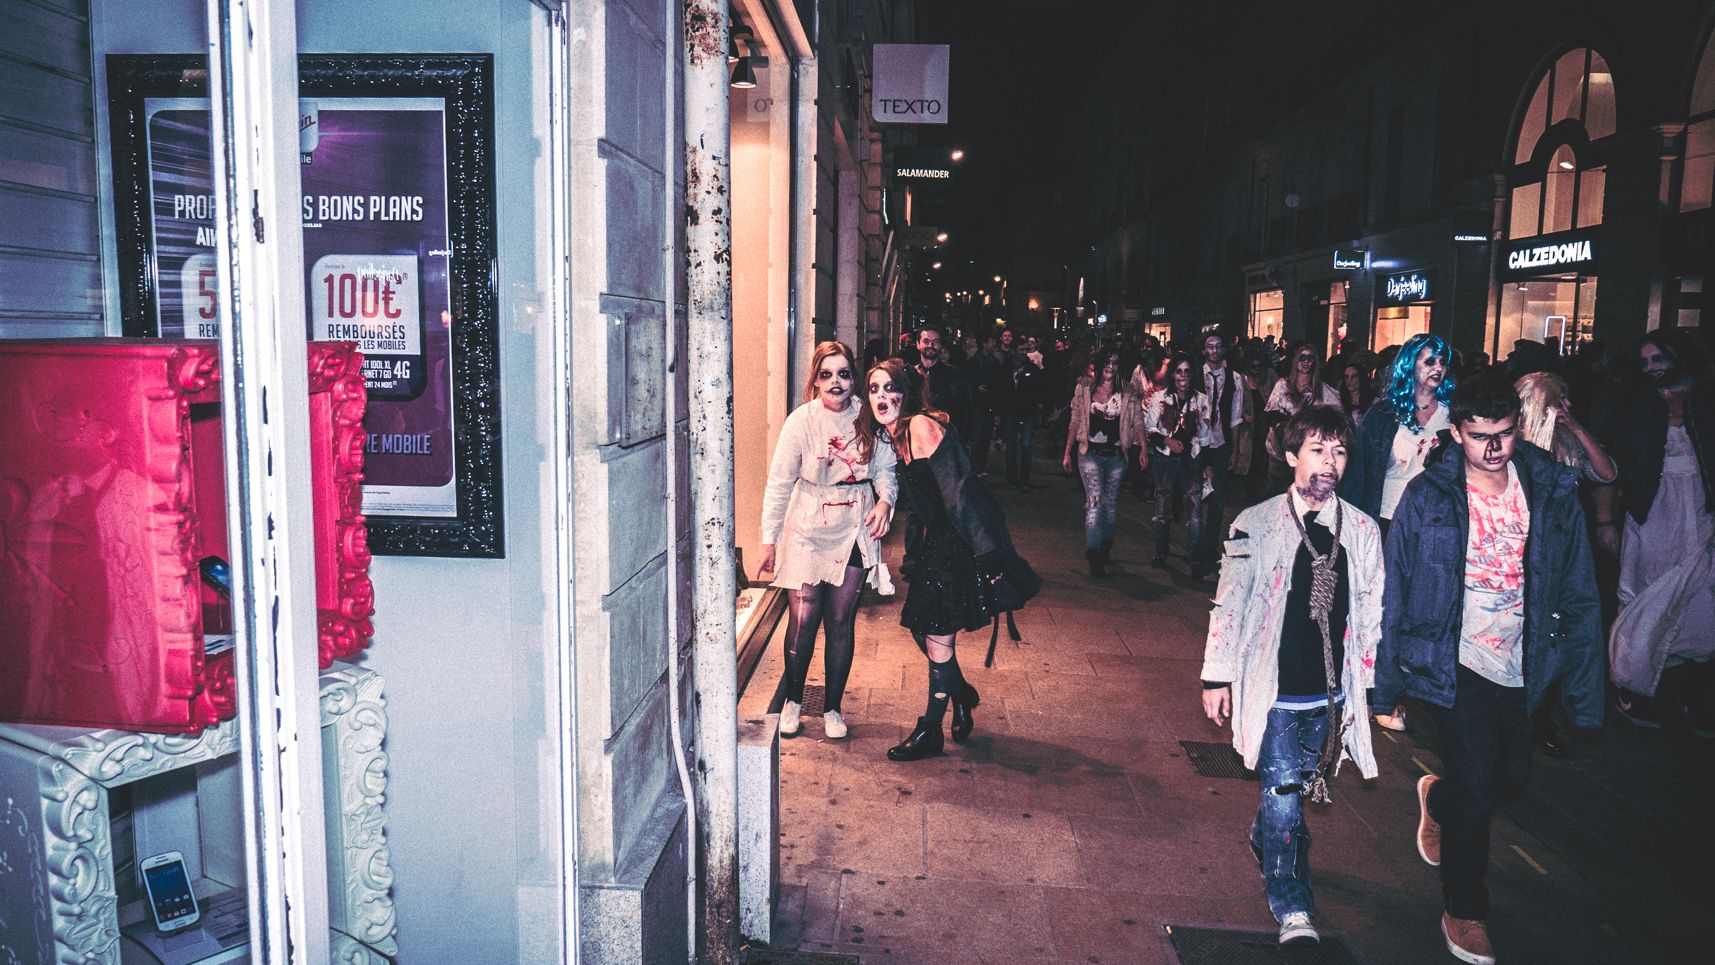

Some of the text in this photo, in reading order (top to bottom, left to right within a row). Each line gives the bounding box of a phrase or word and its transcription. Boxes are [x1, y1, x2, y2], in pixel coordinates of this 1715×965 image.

[879, 99, 941, 115] TEXTO
[896, 168, 950, 179] SALAMANDER
[303, 195, 314, 221] S
[318, 195, 364, 221] BONS
[369, 195, 424, 221] PLANS
[1508, 240, 1592, 270] CALZEDONIA
[1387, 274, 1428, 300] Darjeeling
[328, 322, 406, 340] REMBOURSÉS
[364, 341, 375, 350] LES
[377, 341, 406, 350] MOBILES
[378, 370, 383, 378] 7
[393, 361, 411, 379] 4G
[374, 381, 381, 389] 24
[382, 433, 432, 455] MOBILE
